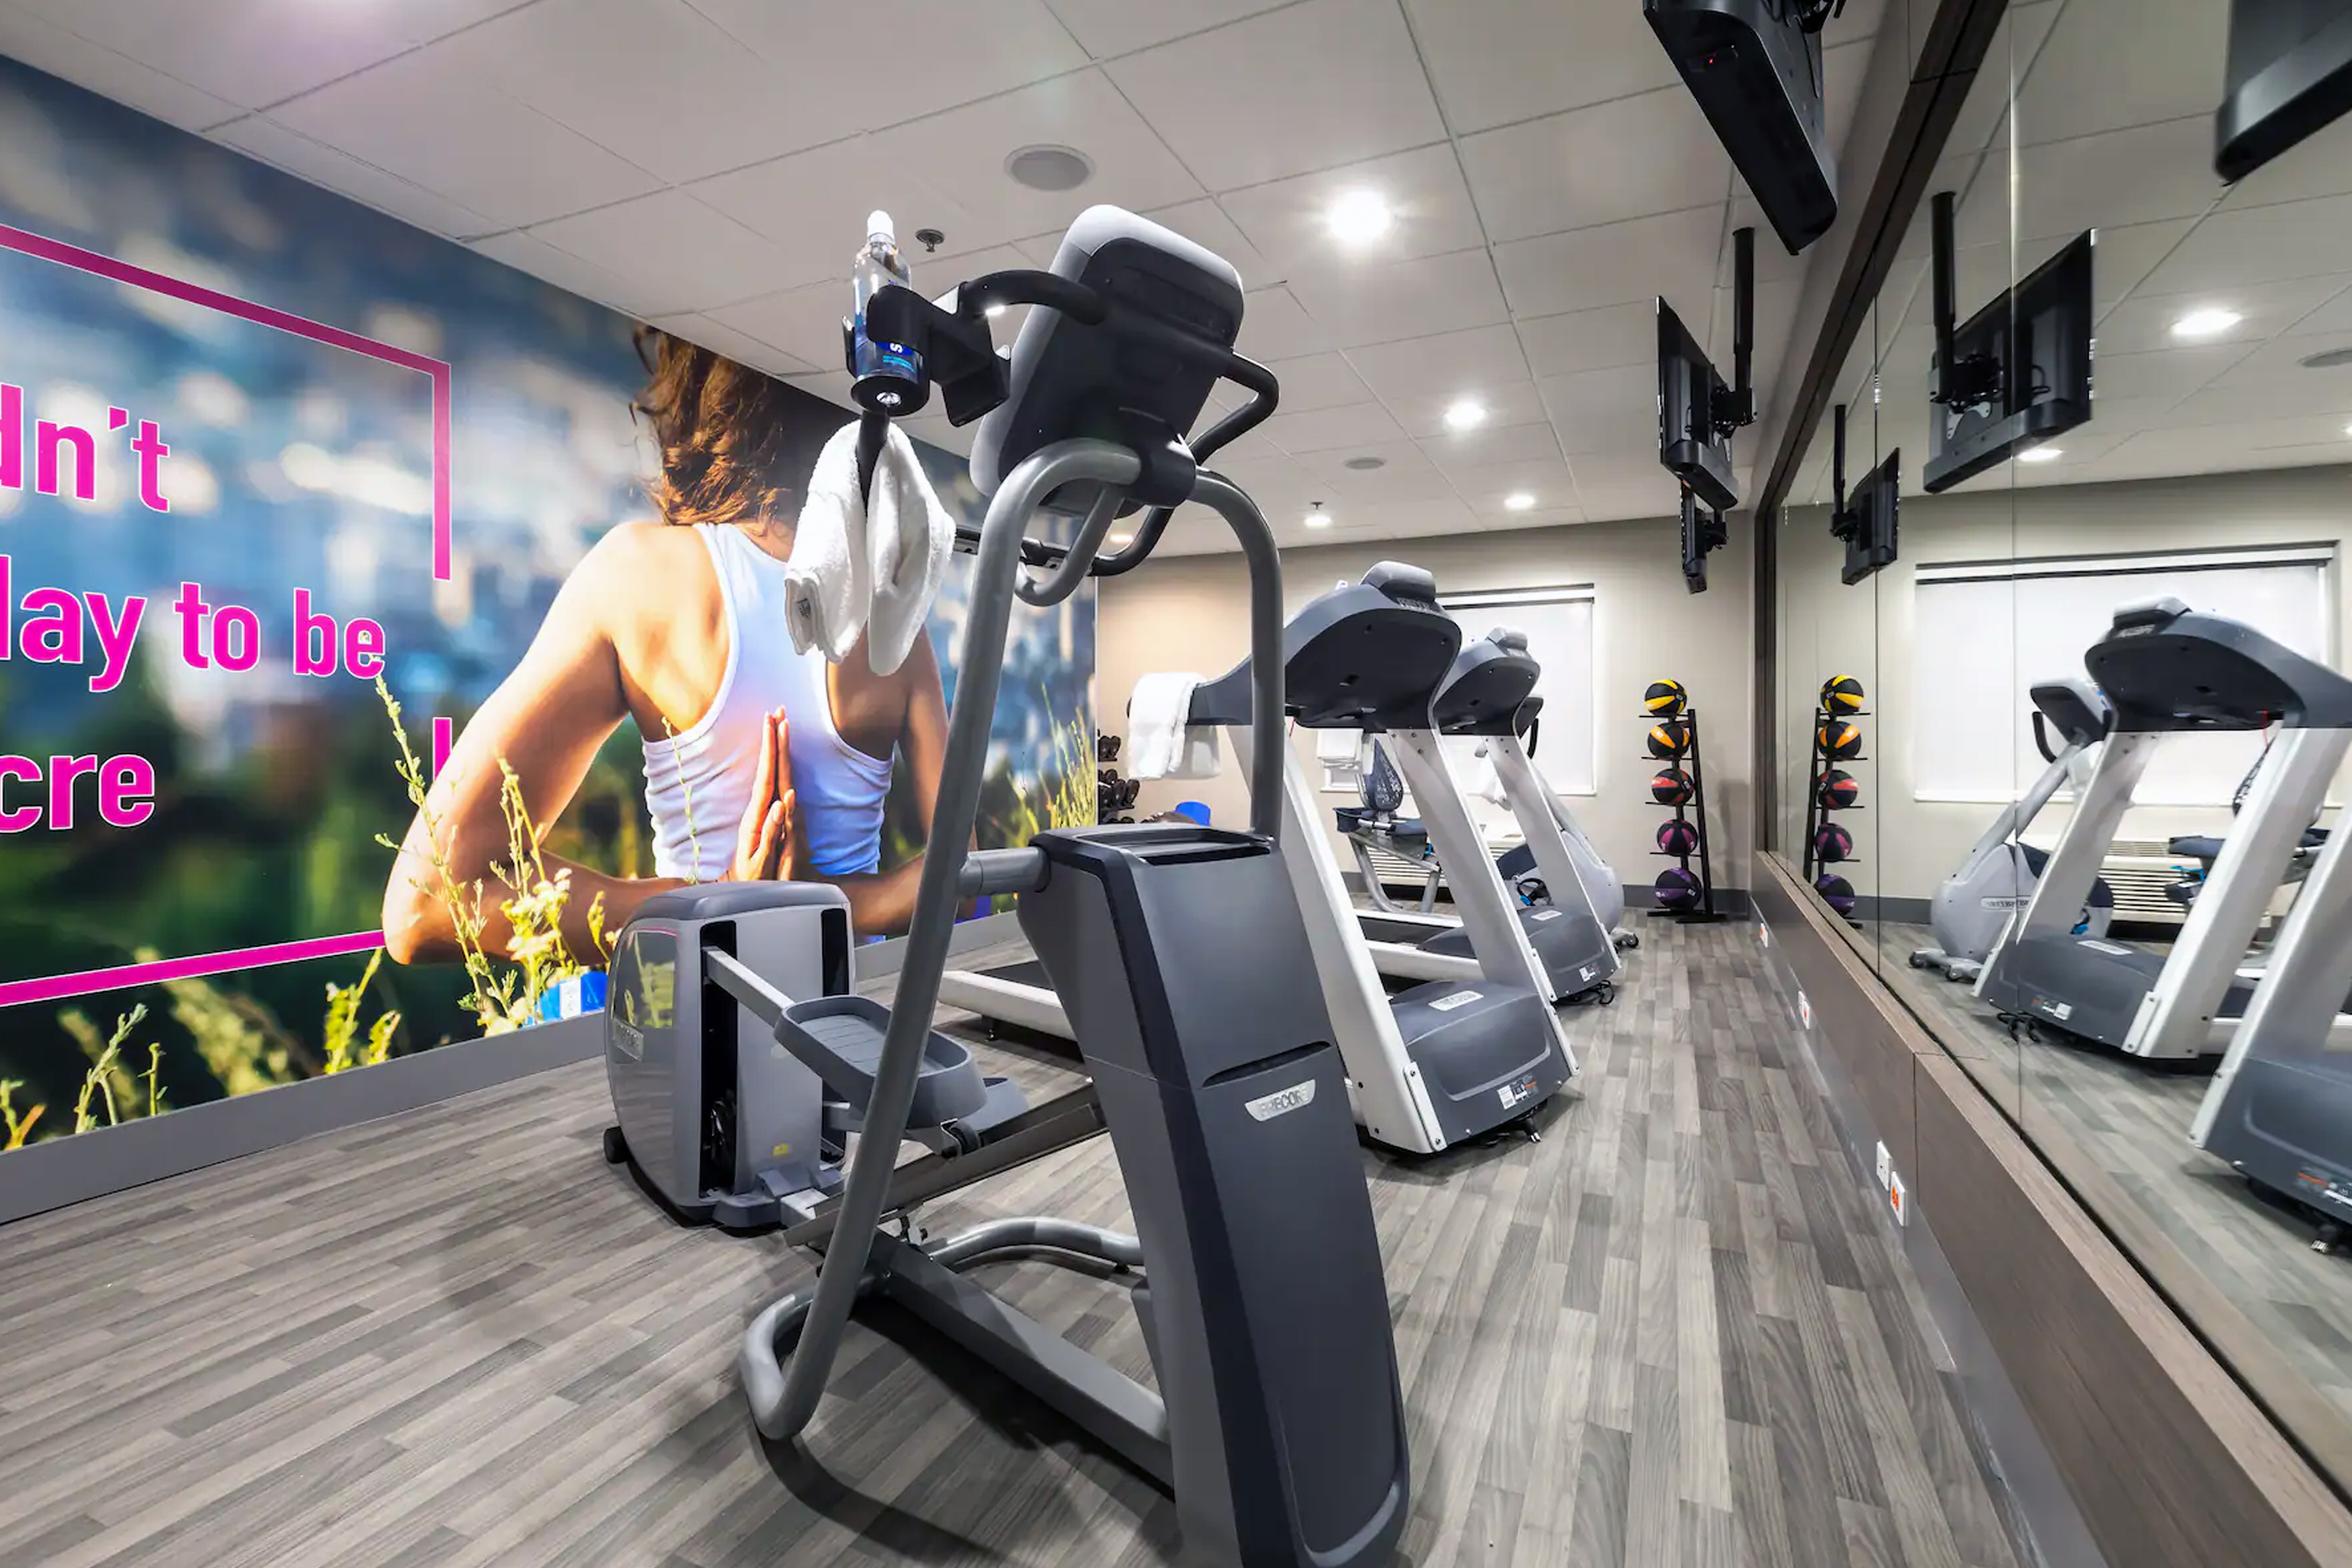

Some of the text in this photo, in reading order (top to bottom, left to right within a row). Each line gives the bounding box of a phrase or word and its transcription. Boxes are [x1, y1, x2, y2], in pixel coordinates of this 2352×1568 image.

[172, 582, 261, 672] to
[293, 587, 386, 679] be
[0, 754, 155, 833] cre
